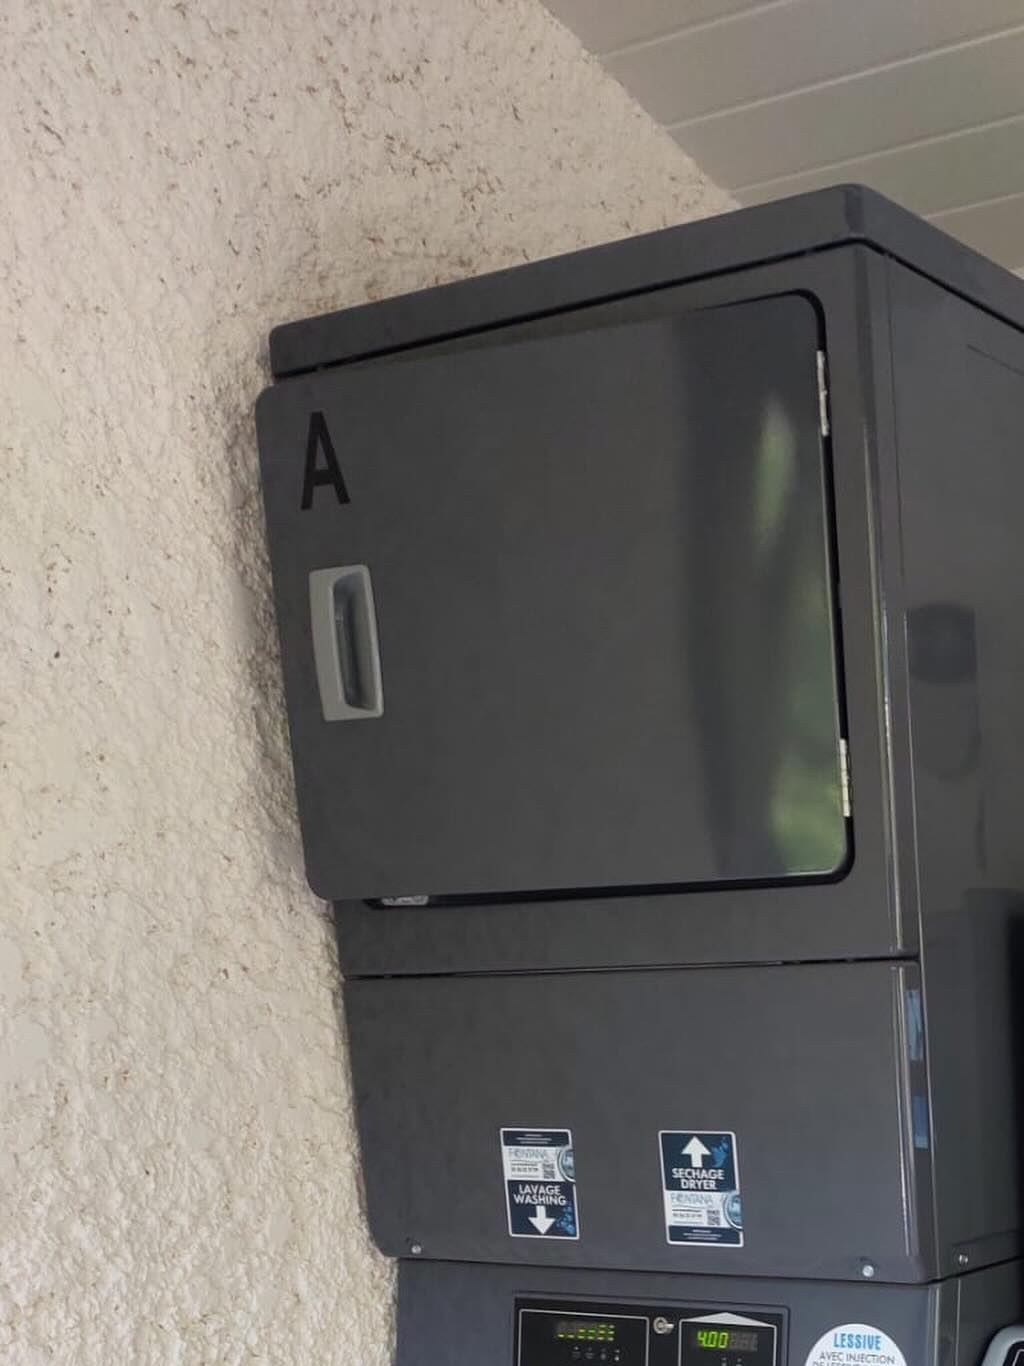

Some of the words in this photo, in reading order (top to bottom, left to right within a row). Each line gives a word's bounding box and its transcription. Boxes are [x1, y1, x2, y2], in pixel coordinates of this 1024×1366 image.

[301, 411, 350, 509] A
[672, 1168, 725, 1180] SECHAGE
[519, 1184, 561, 1195] LAVAGE
[681, 1179, 717, 1190] DRYER
[513, 1194, 567, 1206] WASHING
[833, 1333, 881, 1350] LESSIVE
[820, 1352, 844, 1362] AVEC
[846, 1353, 895, 1365] INJECTION
